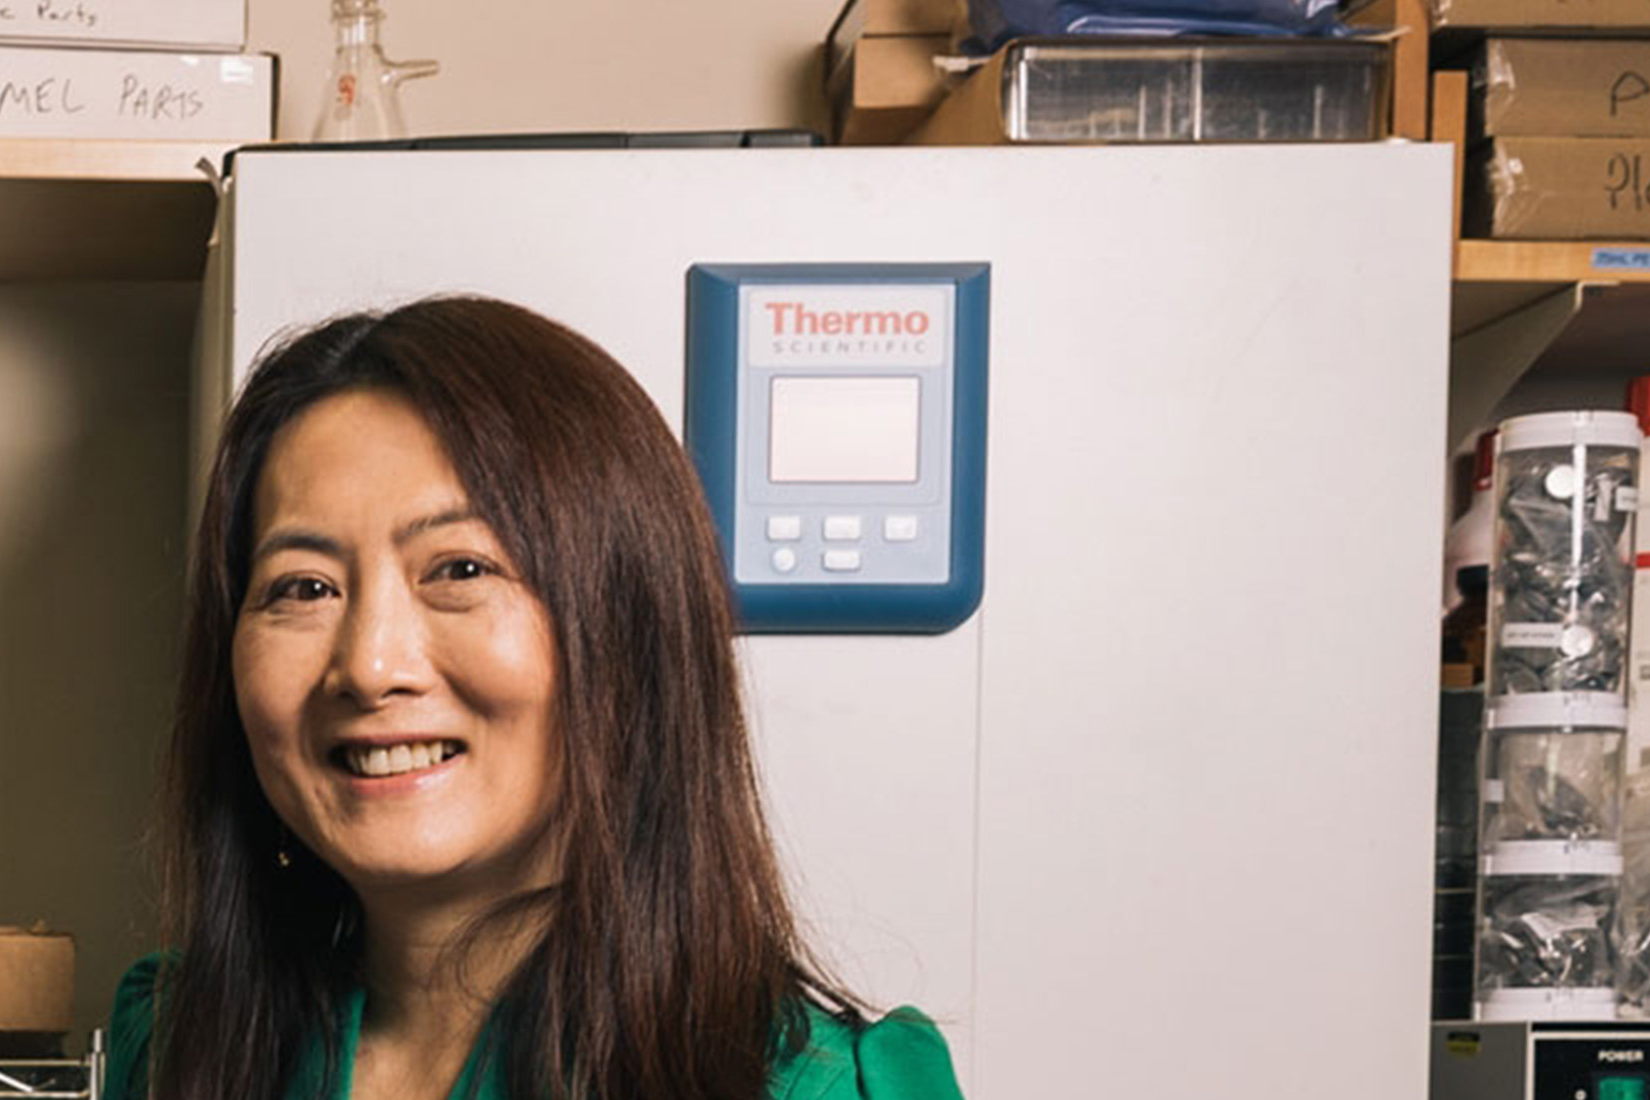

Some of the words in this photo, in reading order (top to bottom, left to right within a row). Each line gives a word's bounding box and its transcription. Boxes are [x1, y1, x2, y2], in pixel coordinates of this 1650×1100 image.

[36, 0, 97, 27] Parts
[118, 73, 205, 119] PARTS
[764, 301, 930, 336] Thermo
[772, 340, 926, 355] SCIENTIFIC
[1597, 1049, 1645, 1062] POWER
